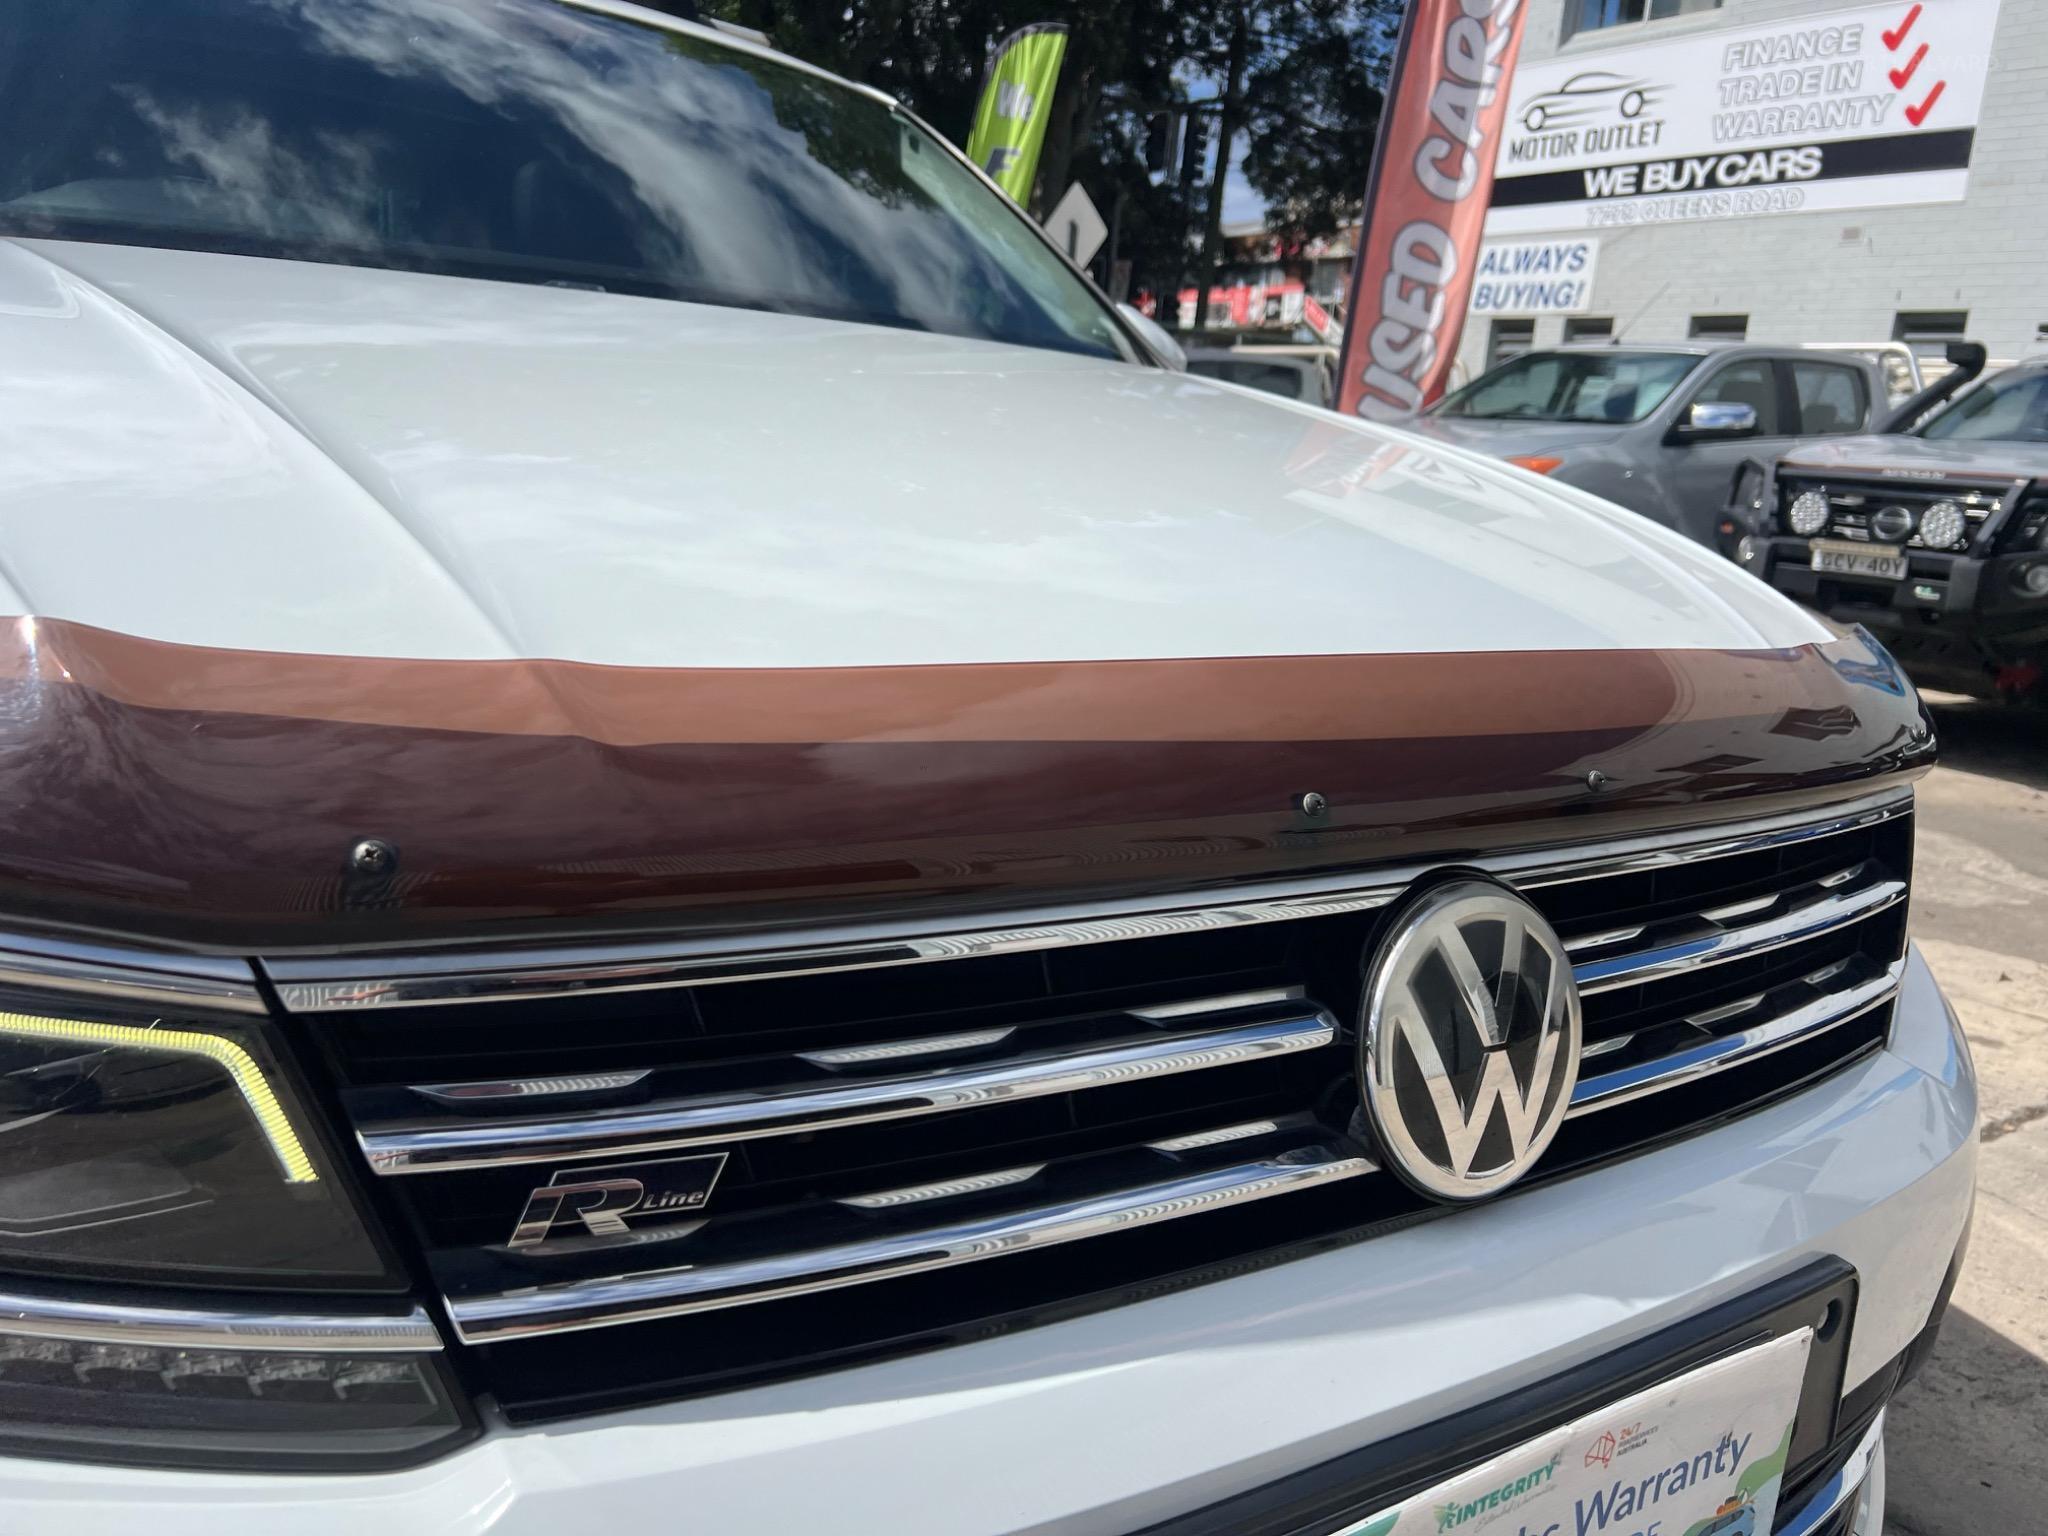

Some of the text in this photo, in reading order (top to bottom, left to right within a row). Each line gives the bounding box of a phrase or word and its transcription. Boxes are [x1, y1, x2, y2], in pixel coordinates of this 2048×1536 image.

[1723, 24, 1863, 73] FINANCE
[1719, 60, 1863, 107] TRADE IN
[1508, 119, 1665, 163] MOTOR OUTLET
[1712, 93, 1895, 143] WARRANTY
[1583, 146, 1823, 198] WE BUY CARS
[1639, 194, 1731, 223] QUEENS
[1732, 186, 1806, 214] ROAD
[1479, 243, 1589, 275] ALWAYS
[1473, 280, 1585, 310] BUYING!
[1358, 222, 1458, 420] USED
[508, 1178, 705, 1248] R Line
[1456, 1463, 1556, 1524] INTEGRITY
[1574, 1432, 1752, 1535] Warranty
